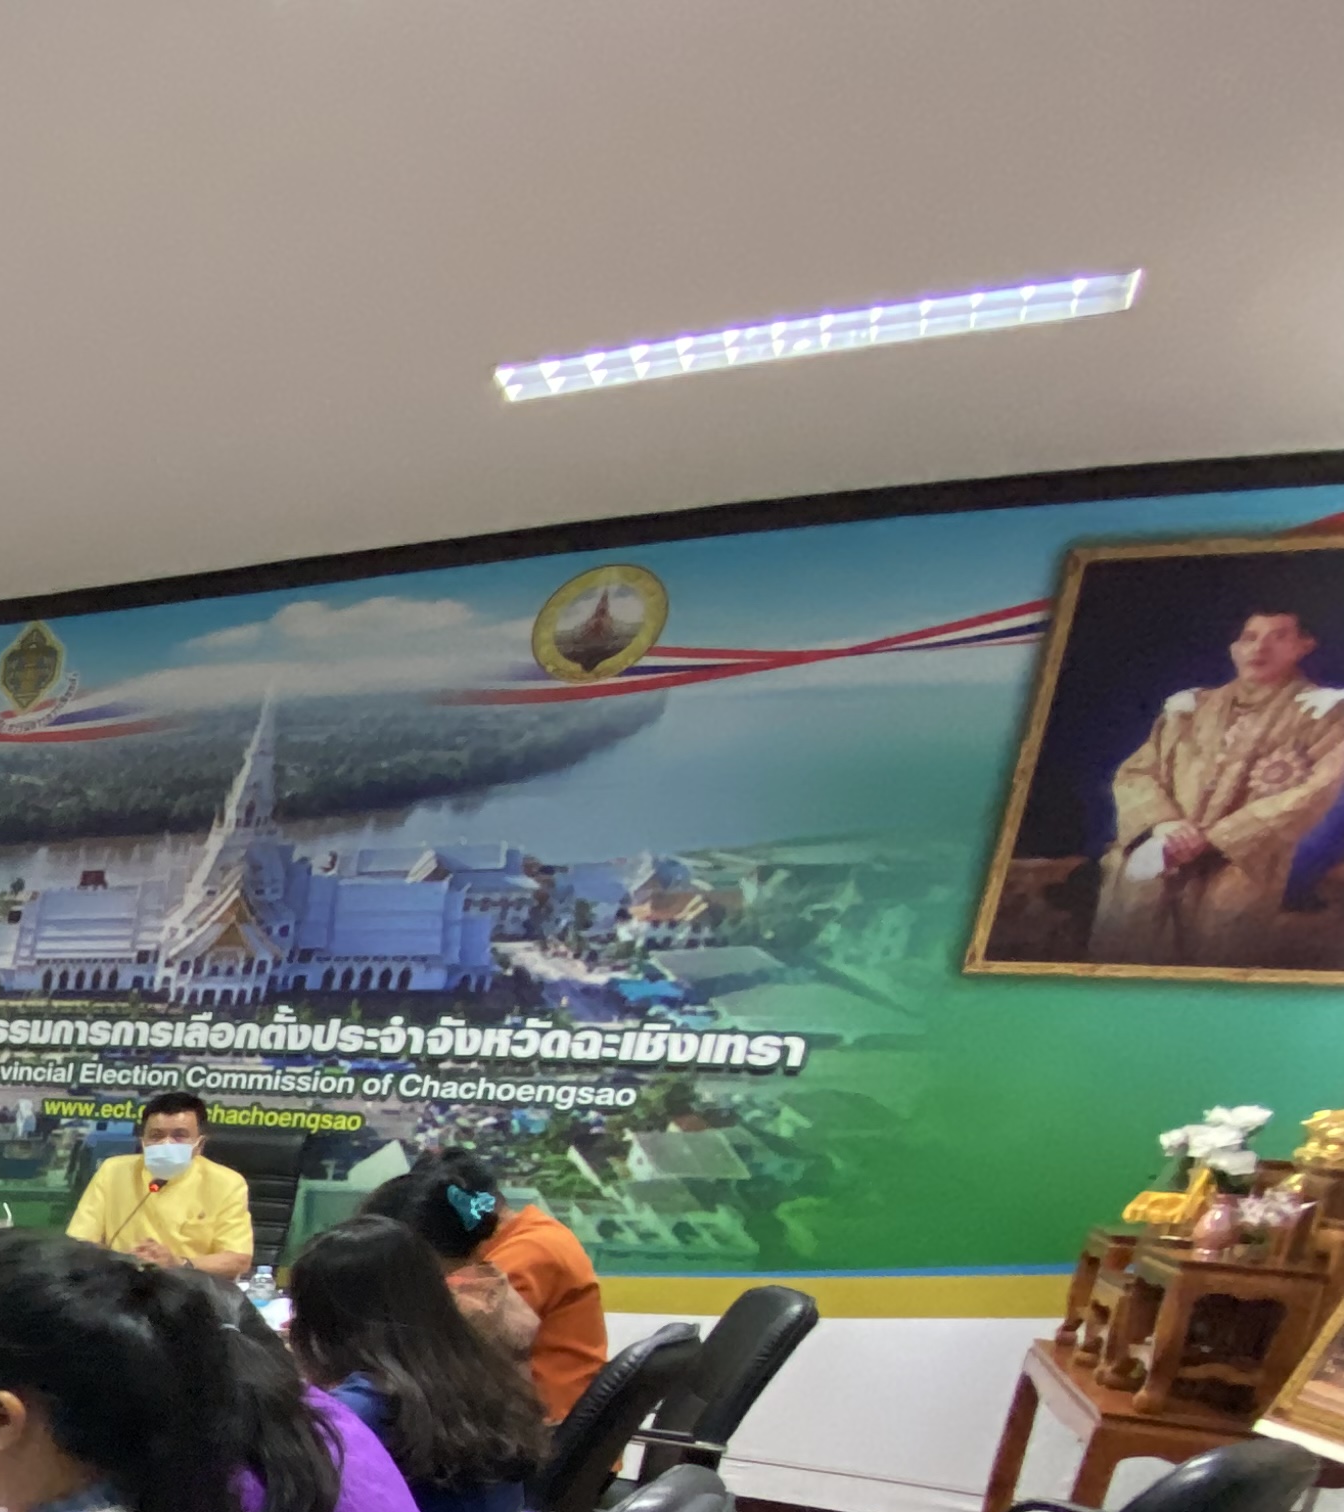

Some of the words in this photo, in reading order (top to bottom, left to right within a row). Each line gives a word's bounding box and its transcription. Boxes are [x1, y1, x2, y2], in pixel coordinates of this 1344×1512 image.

[78, 1062, 179, 1087] Election
[184, 1064, 355, 1095] Commission
[361, 1073, 393, 1096] of
[398, 1074, 638, 1111] Chachoengsao
